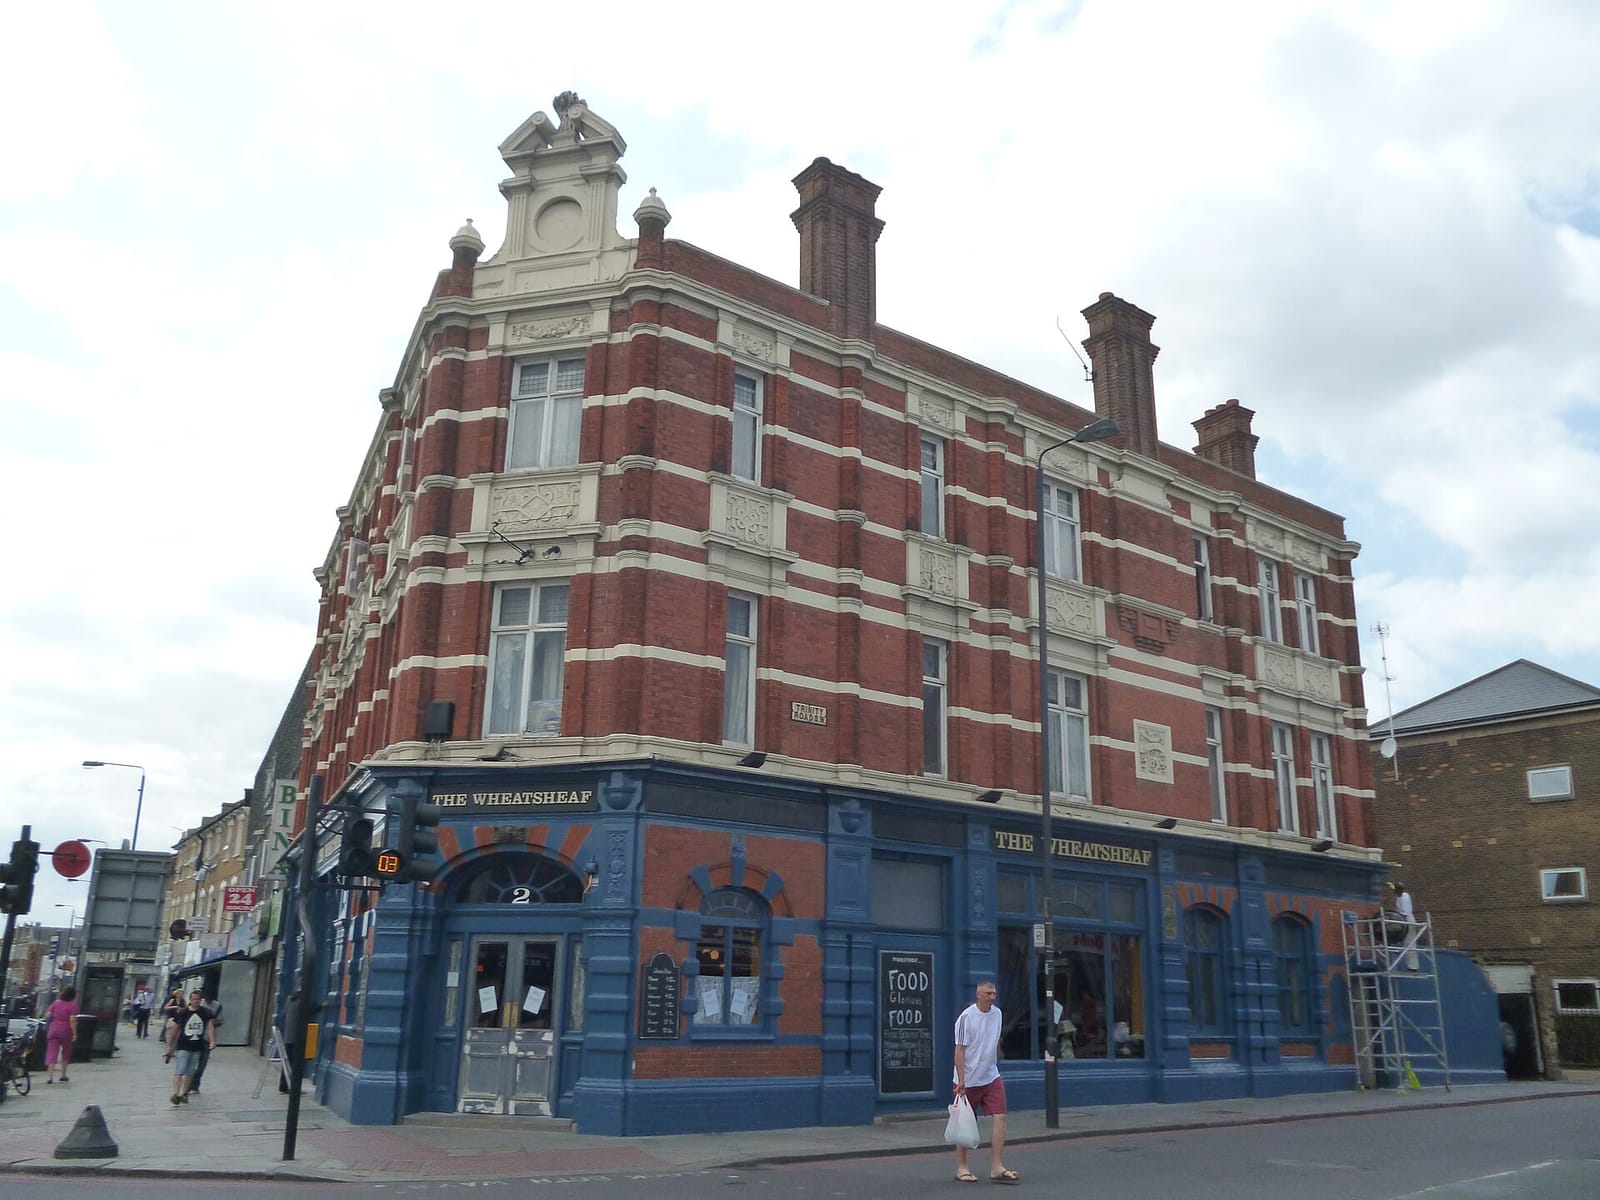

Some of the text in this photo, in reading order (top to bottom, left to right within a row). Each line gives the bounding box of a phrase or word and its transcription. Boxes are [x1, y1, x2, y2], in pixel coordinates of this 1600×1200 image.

[793, 711, 814, 721] ROAD
[796, 704, 824, 715] TRINITY
[432, 790, 593, 807] THE WHEATSHEAF
[995, 831, 1034, 852] THE
[377, 855, 399, 873] 03
[228, 893, 252, 906] 24
[511, 887, 531, 904] 2
[889, 969, 929, 991] FOOD
[888, 1009, 923, 1028] FOOD
